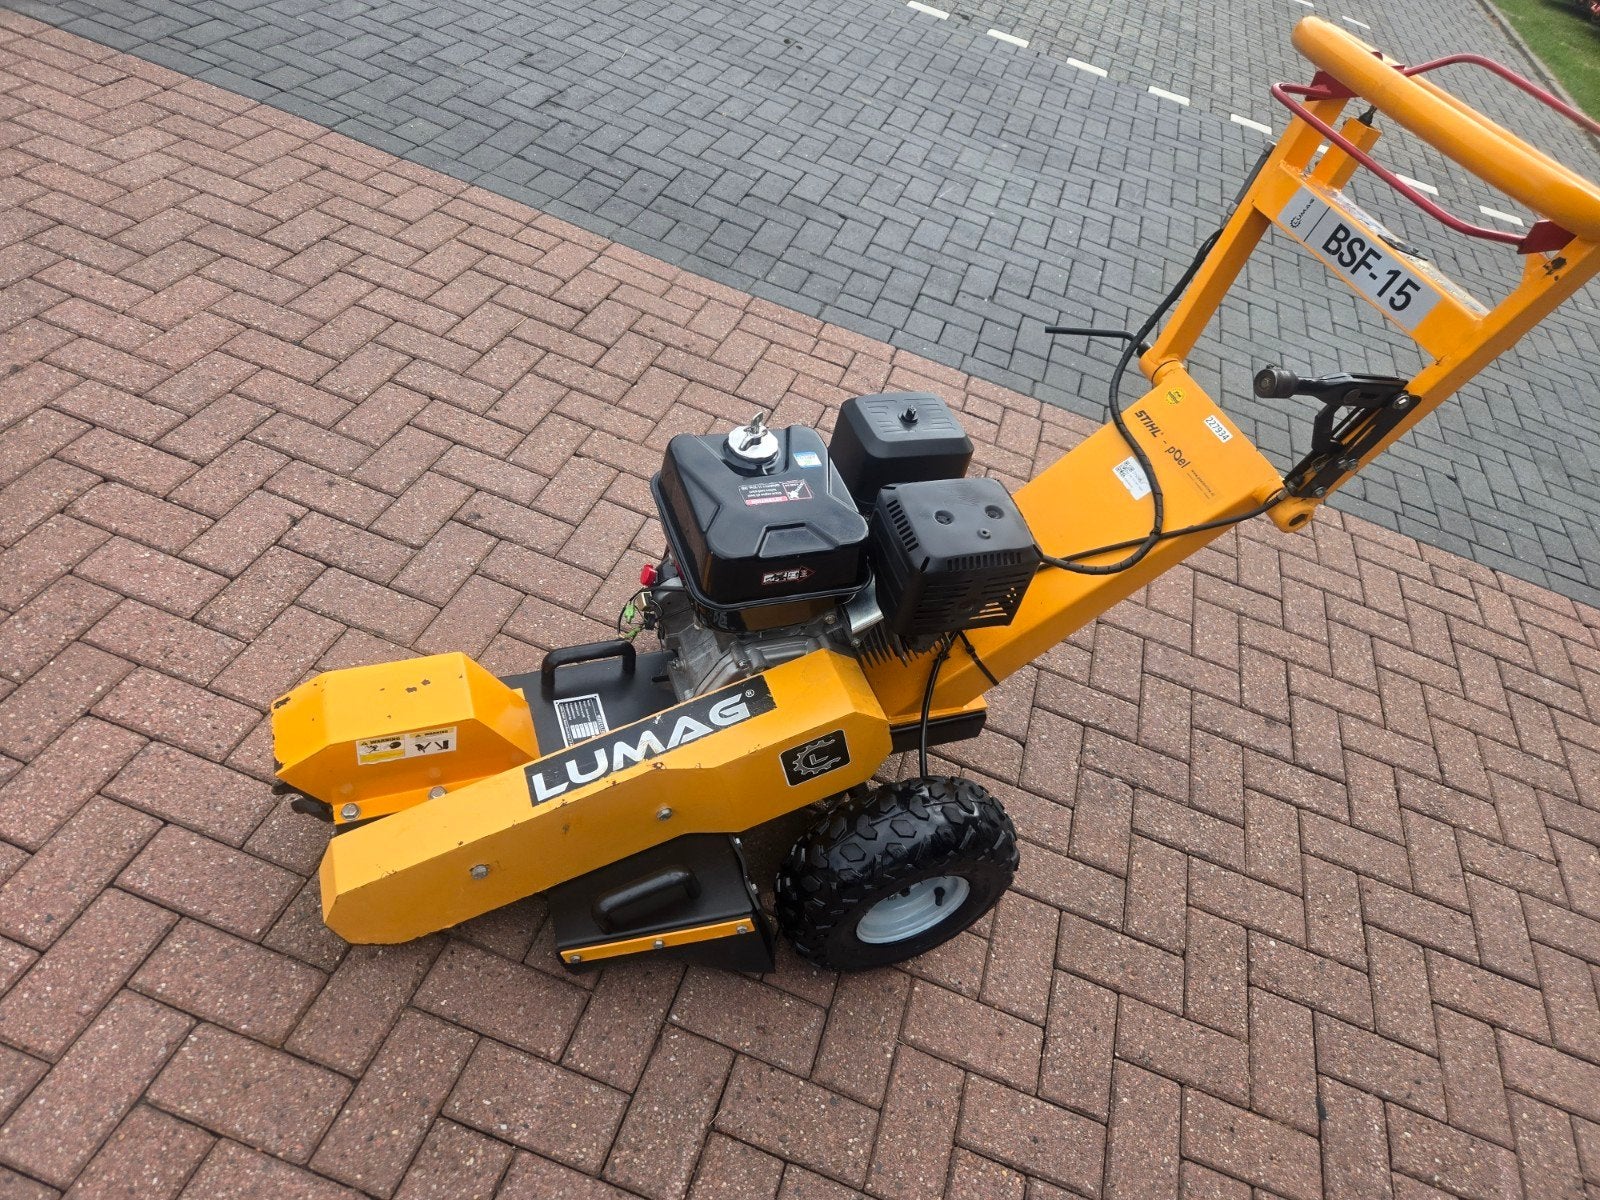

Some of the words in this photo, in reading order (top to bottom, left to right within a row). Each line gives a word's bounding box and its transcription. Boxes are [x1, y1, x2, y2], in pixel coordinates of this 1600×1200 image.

[1322, 222, 1421, 312] BSF-15
[1134, 409, 1161, 438] STIHL
[1205, 416, 1230, 441] 227934
[531, 692, 751, 802] LUMAG
